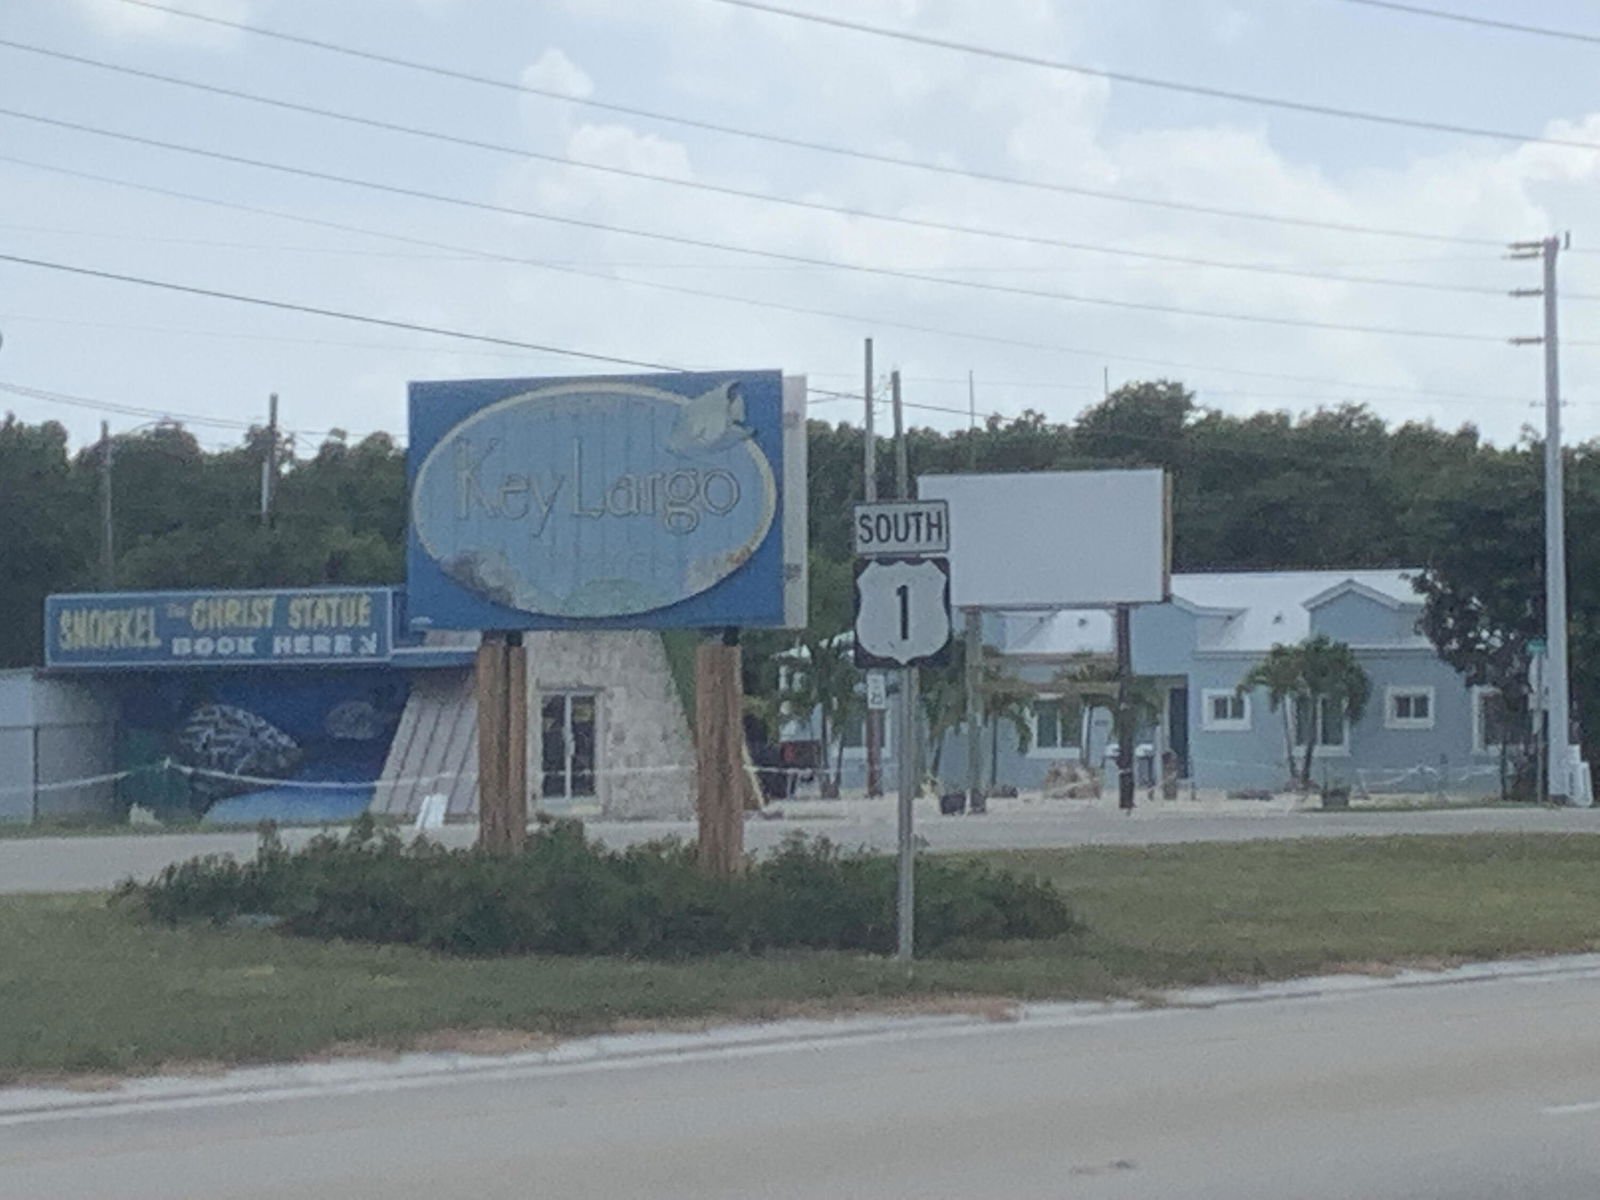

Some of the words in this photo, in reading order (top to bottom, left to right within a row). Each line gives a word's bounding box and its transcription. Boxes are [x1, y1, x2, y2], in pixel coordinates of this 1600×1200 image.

[453, 436, 565, 538] Key
[572, 436, 741, 535] Largo
[858, 510, 943, 544] SOUTH
[59, 607, 162, 650] SNORKEL
[191, 596, 275, 630] CHRIST
[288, 592, 372, 630] STATUE
[896, 584, 909, 640] 1
[171, 636, 257, 656] BOOK
[272, 634, 354, 656] HERE
